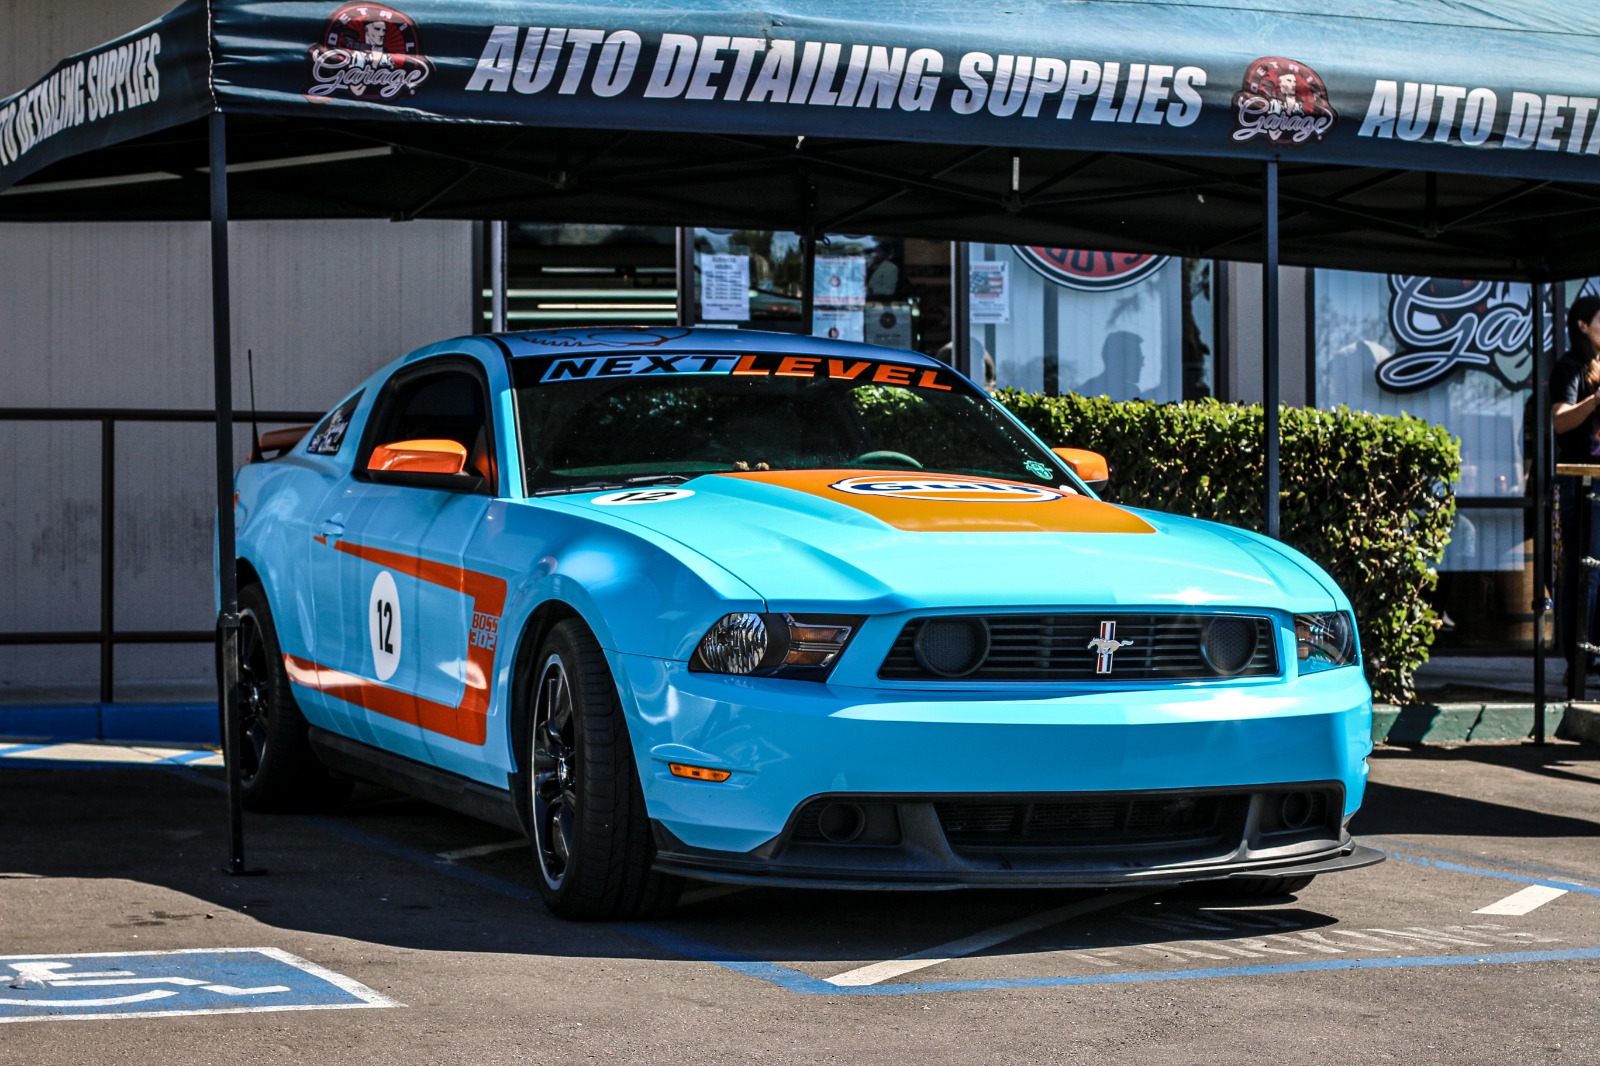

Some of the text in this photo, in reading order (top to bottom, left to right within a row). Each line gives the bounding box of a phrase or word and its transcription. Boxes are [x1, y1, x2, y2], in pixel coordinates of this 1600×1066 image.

[16, 60, 85, 156] DETAILING
[87, 32, 161, 123] SUPPLIES
[308, 48, 430, 98] Garage
[464, 25, 1207, 128] AUTO DETAILING SUPPLIES
[1232, 96, 1334, 142] Garage
[1357, 79, 1498, 147] AUTO
[610, 491, 677, 502] 12
[377, 599, 394, 655] 12
[470, 628, 498, 651] 302
[472, 612, 499, 634] BOSS
